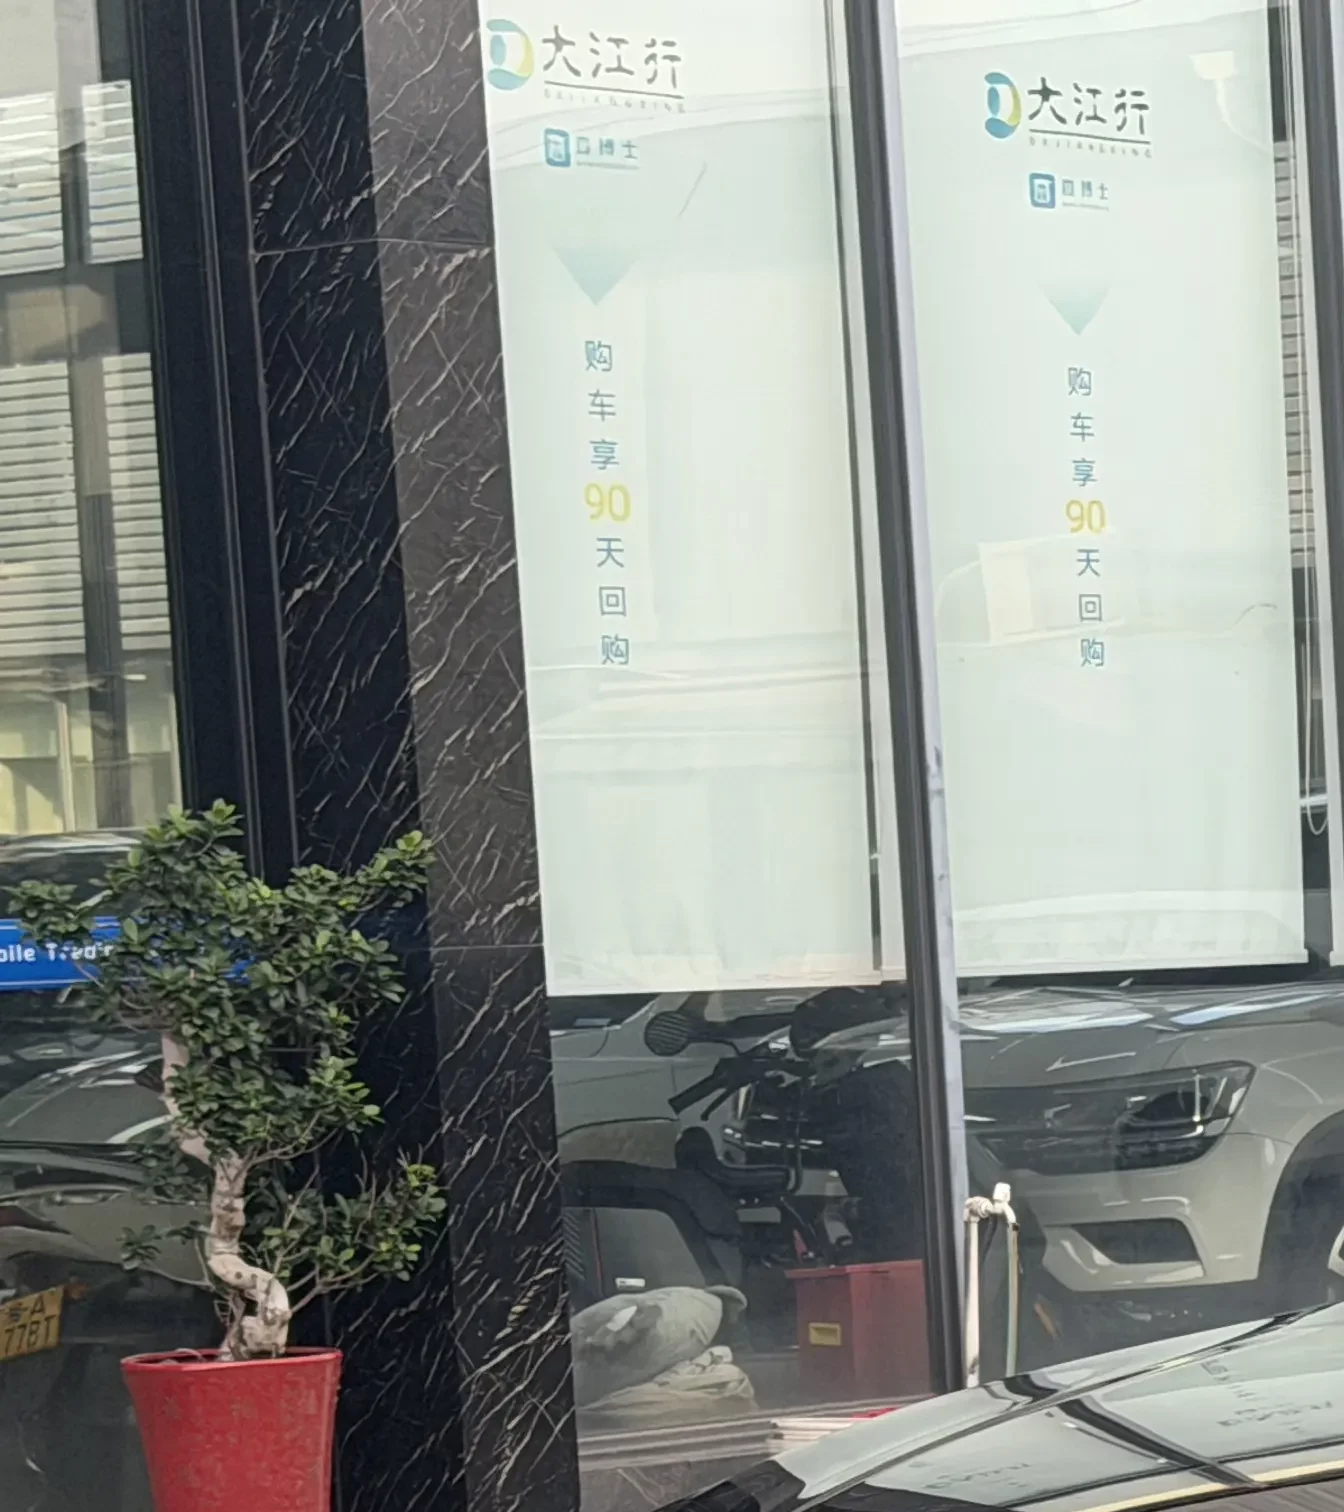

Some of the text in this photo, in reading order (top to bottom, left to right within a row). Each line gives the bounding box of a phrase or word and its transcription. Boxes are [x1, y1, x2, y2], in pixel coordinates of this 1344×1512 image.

[542, 24, 683, 89] 大江行
[1028, 77, 1149, 135] 大江行
